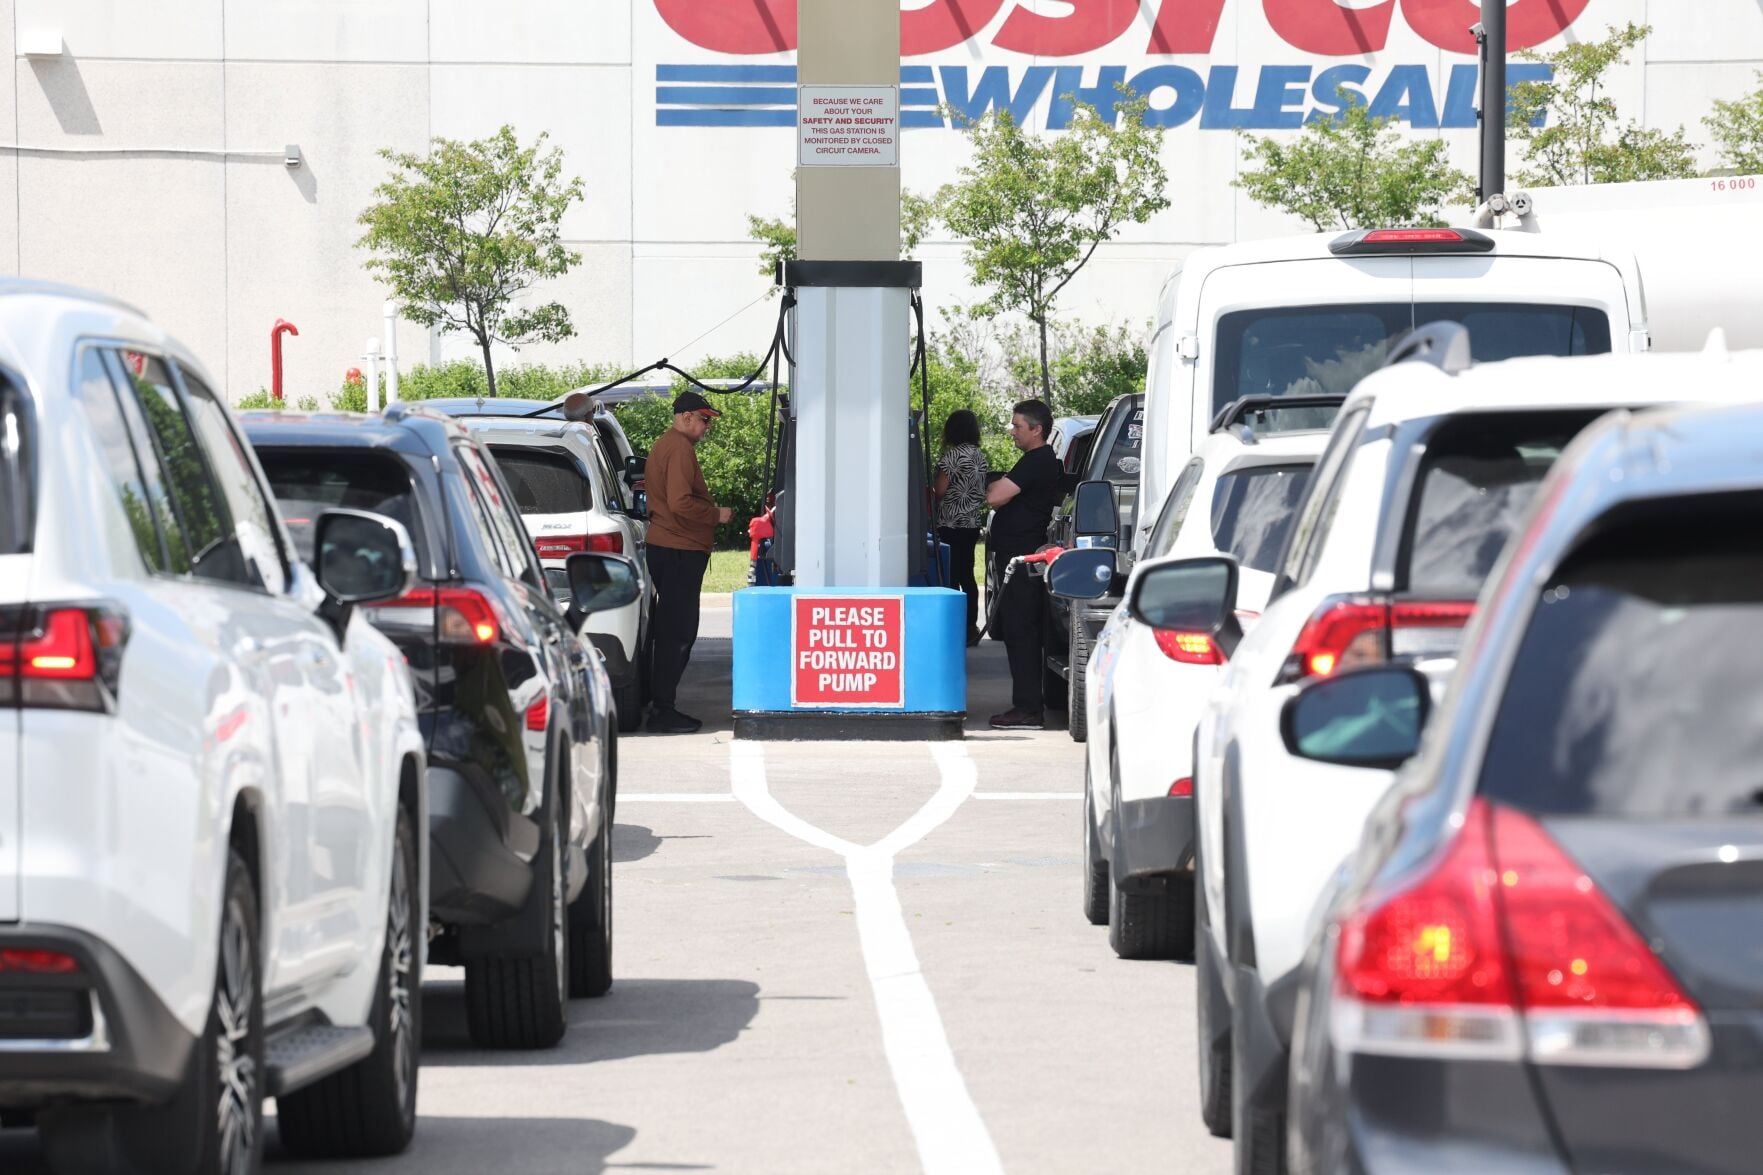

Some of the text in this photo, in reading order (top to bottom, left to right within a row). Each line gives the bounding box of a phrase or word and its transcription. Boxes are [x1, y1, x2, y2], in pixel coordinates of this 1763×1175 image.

[1710, 178, 1755, 191] 16 000
[812, 607, 885, 626] PLEASE
[809, 629, 887, 648] PULL TO
[800, 651, 896, 670] FORWARD
[819, 673, 877, 692] PUMP
